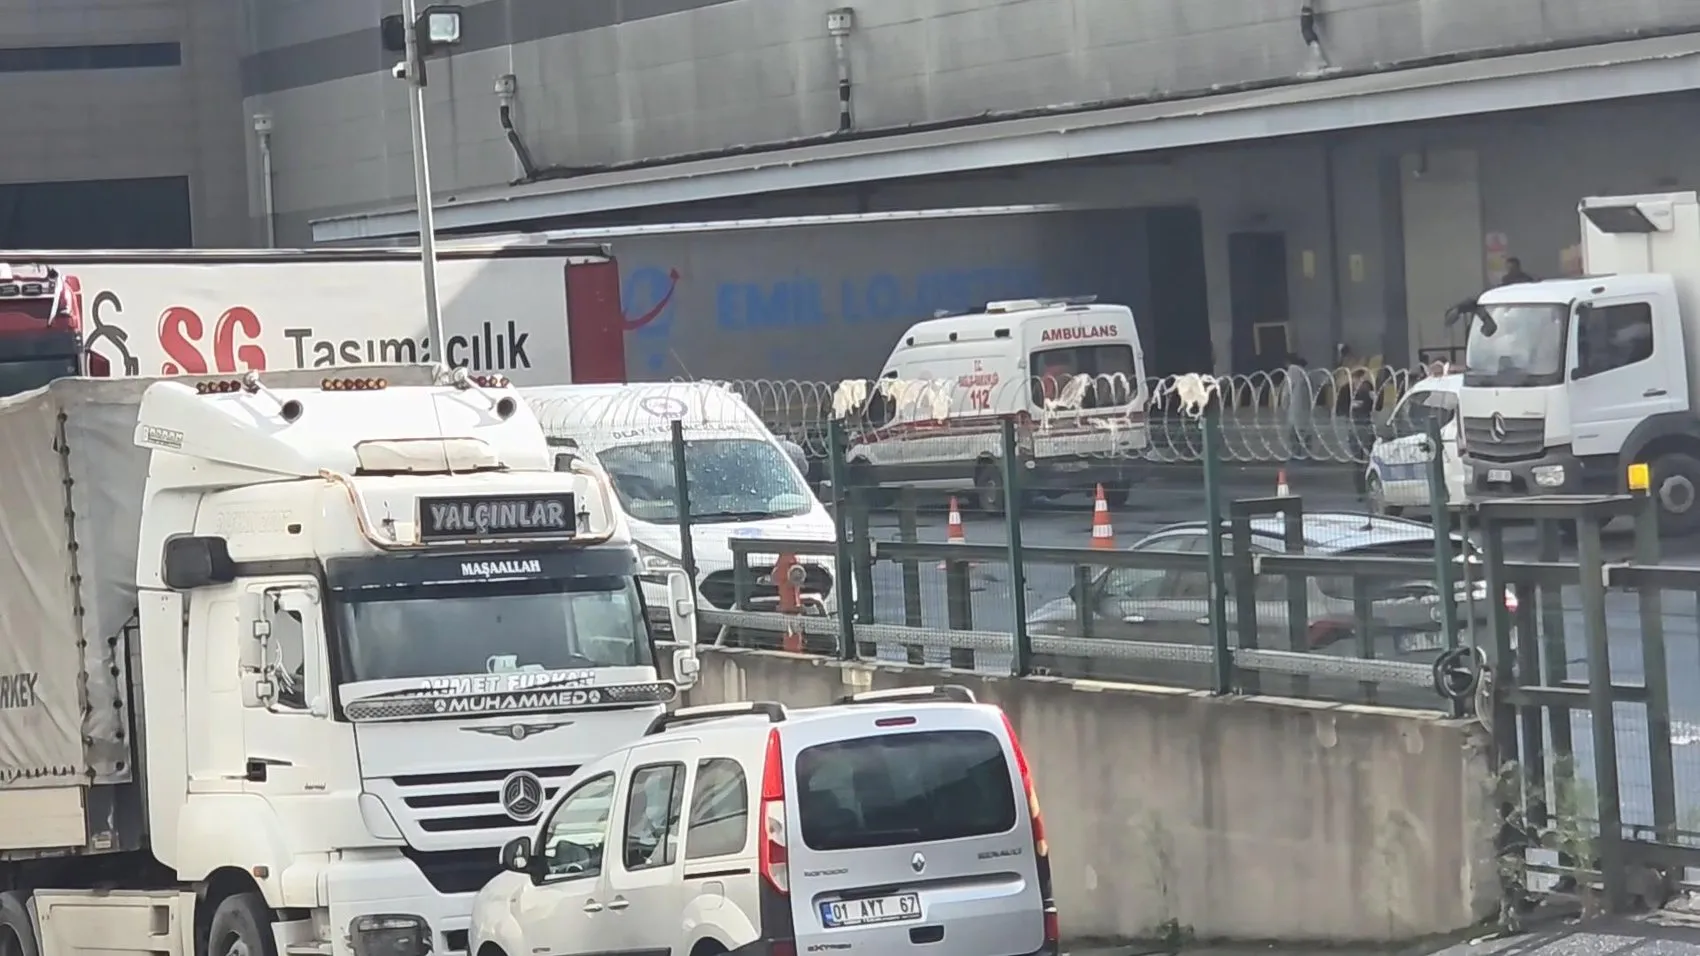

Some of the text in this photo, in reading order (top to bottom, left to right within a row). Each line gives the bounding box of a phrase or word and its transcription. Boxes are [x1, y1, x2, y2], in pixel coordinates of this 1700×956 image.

[158, 305, 266, 375] SG
[1041, 324, 1118, 342] AMBULANS
[970, 389, 992, 409] 112
[430, 500, 566, 534] YALÇINLAR
[461, 559, 541, 577] MAŞAALLAH
[418, 676, 500, 696] AHMET
[449, 690, 587, 711] MUHAMMED
[833, 896, 915, 920] 01 AYT 67
